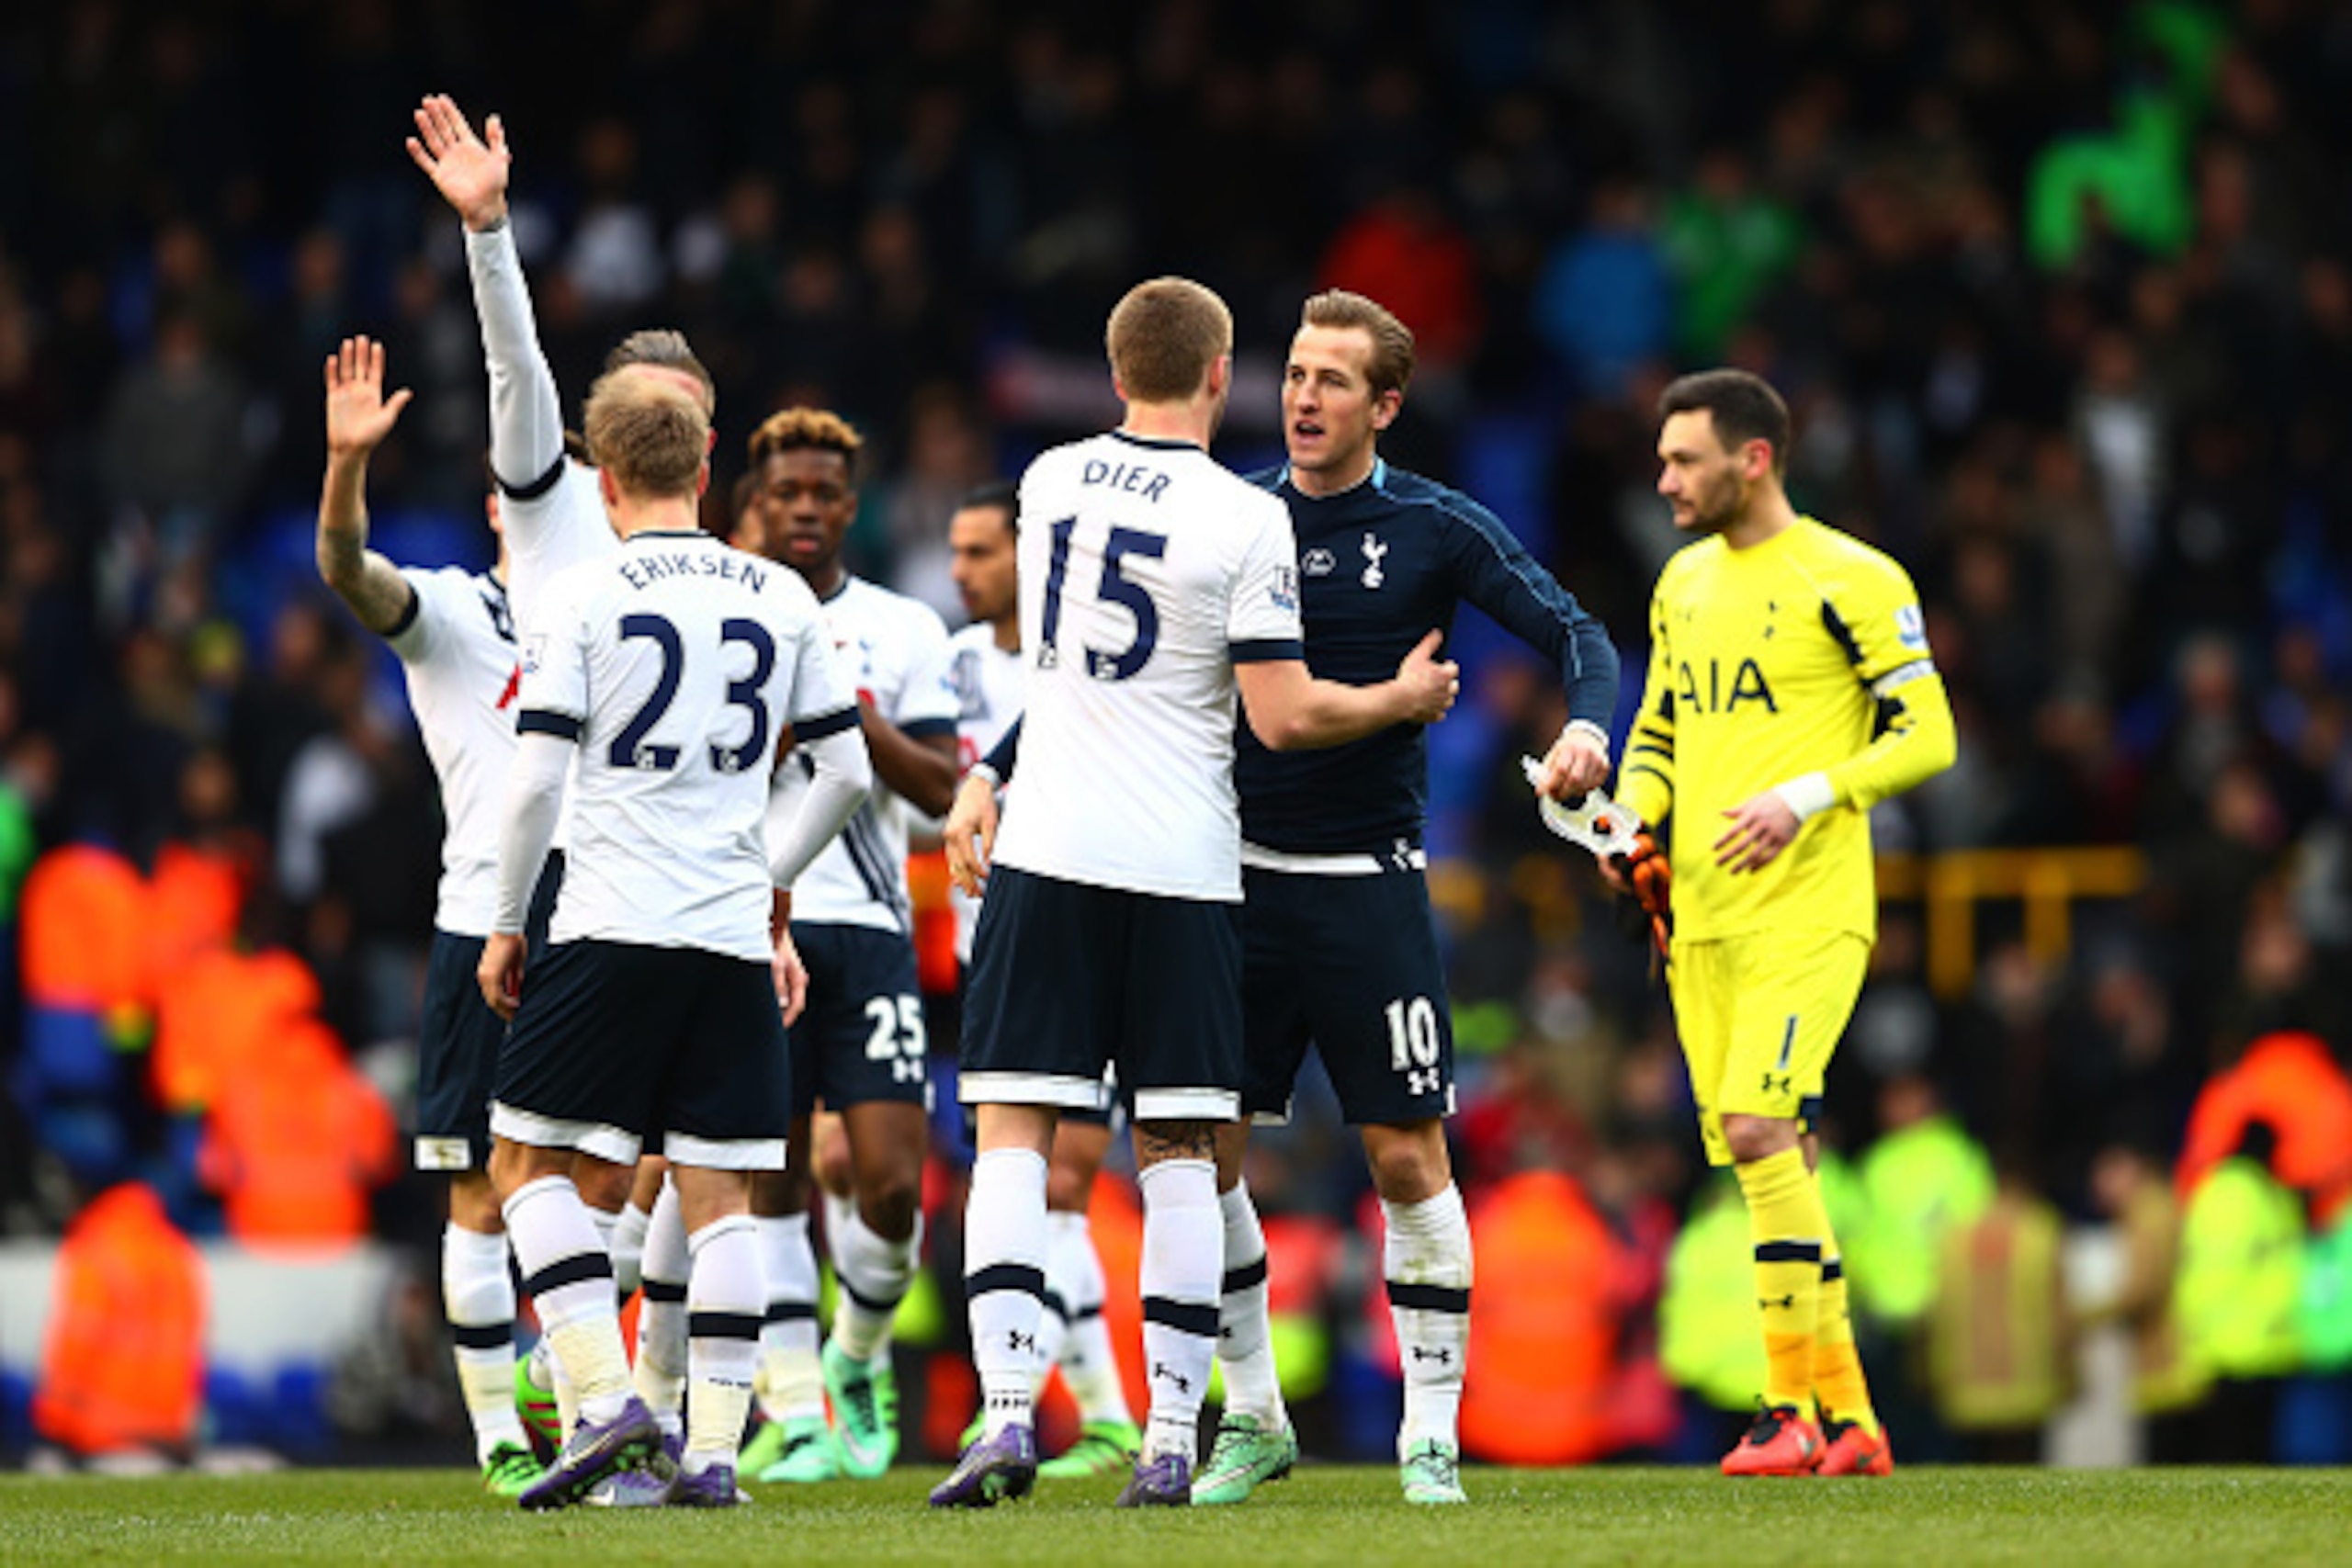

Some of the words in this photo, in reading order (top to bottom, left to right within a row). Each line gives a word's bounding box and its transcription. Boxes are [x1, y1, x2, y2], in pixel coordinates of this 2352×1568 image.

[1081, 459, 1171, 503] DIER
[618, 552, 768, 593] ERIKSEN
[1037, 515, 1168, 680] 15
[608, 613, 776, 771] 23
[1679, 658, 1779, 713] AIA
[865, 994, 925, 1060] 25
[1384, 996, 1440, 1071] 10
[1777, 1014, 1798, 1068] 1
